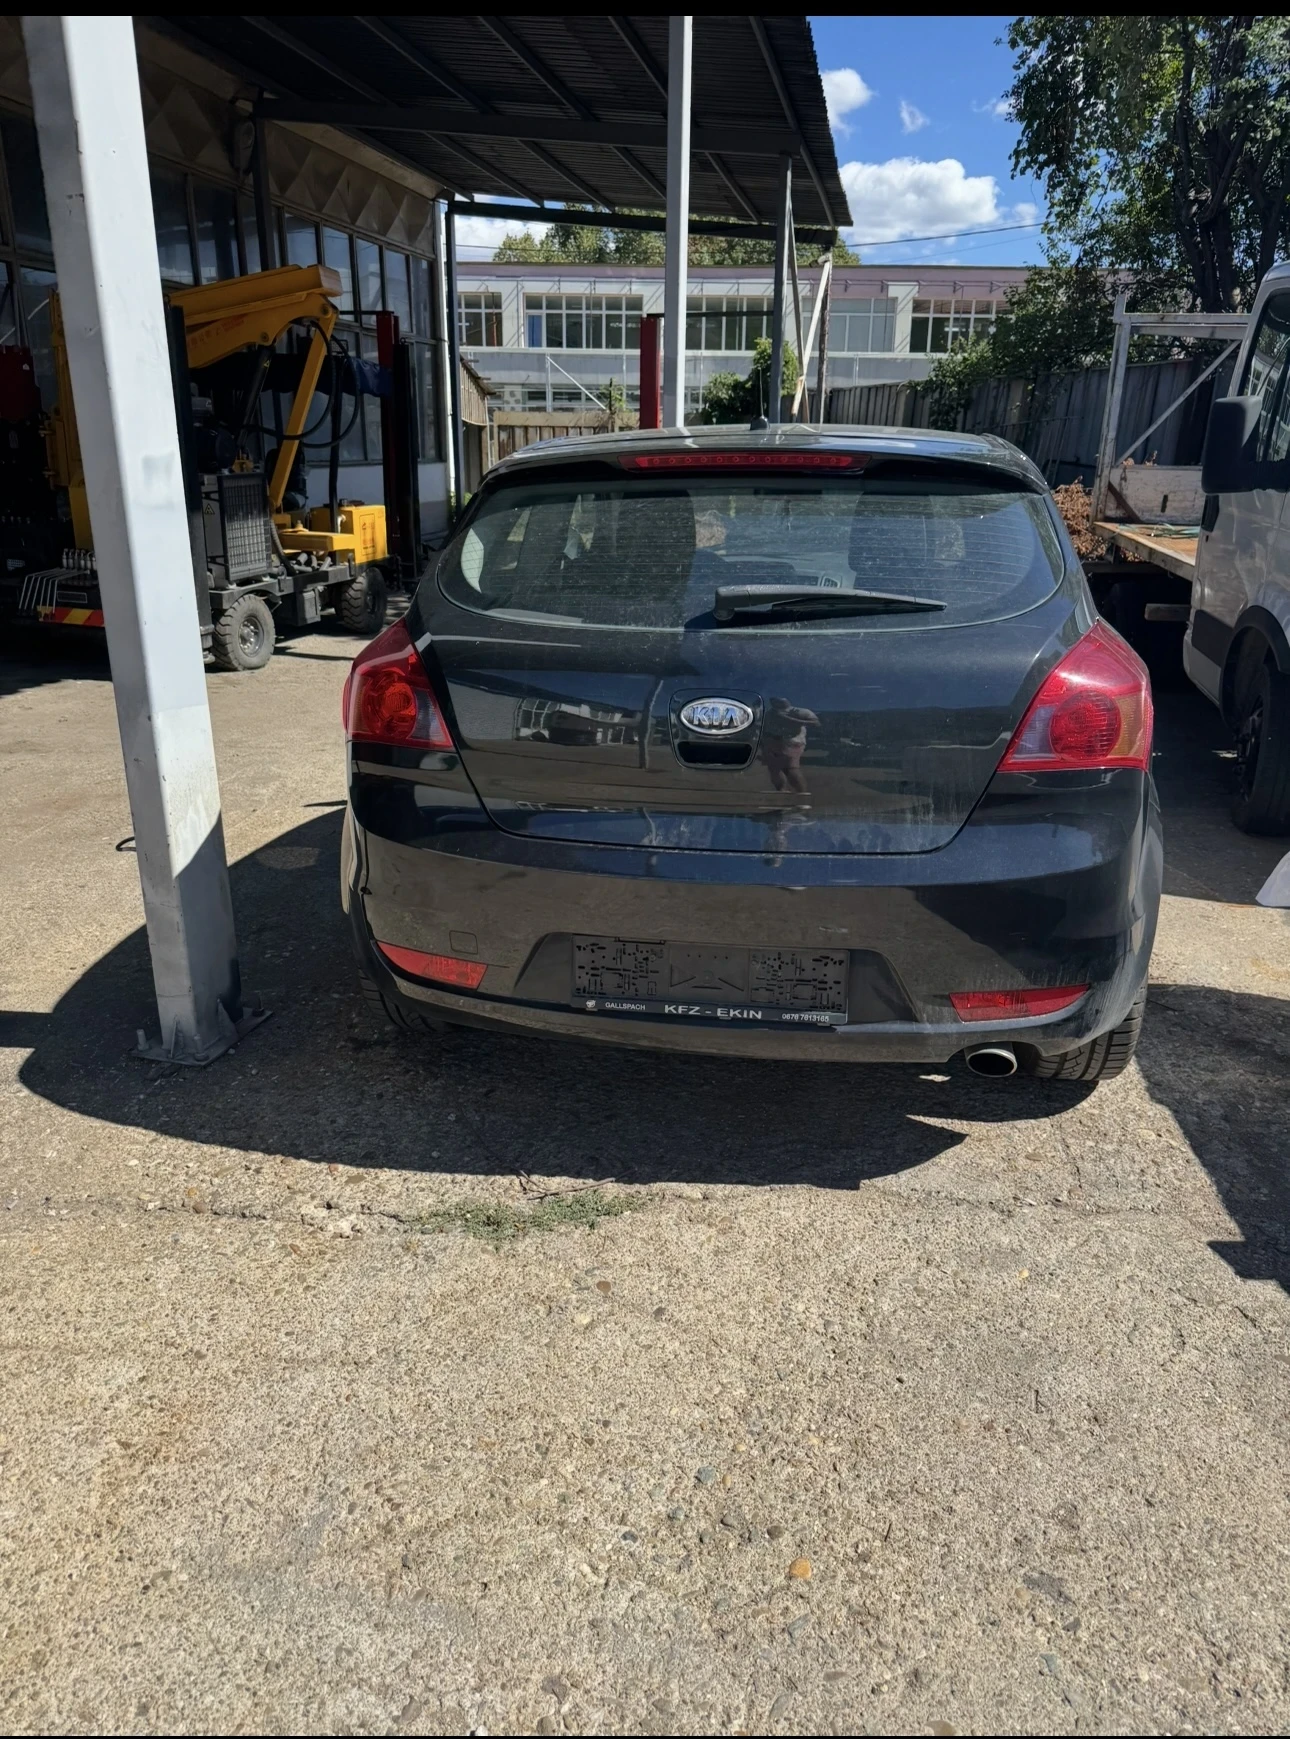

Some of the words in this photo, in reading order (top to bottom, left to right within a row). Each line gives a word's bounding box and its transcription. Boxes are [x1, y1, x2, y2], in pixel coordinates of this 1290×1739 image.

[692, 706, 741, 727] KIA
[605, 1002, 646, 1011] GALLSPACH
[664, 1004, 701, 1015] KFZ
[717, 1008, 762, 1020] EKIN
